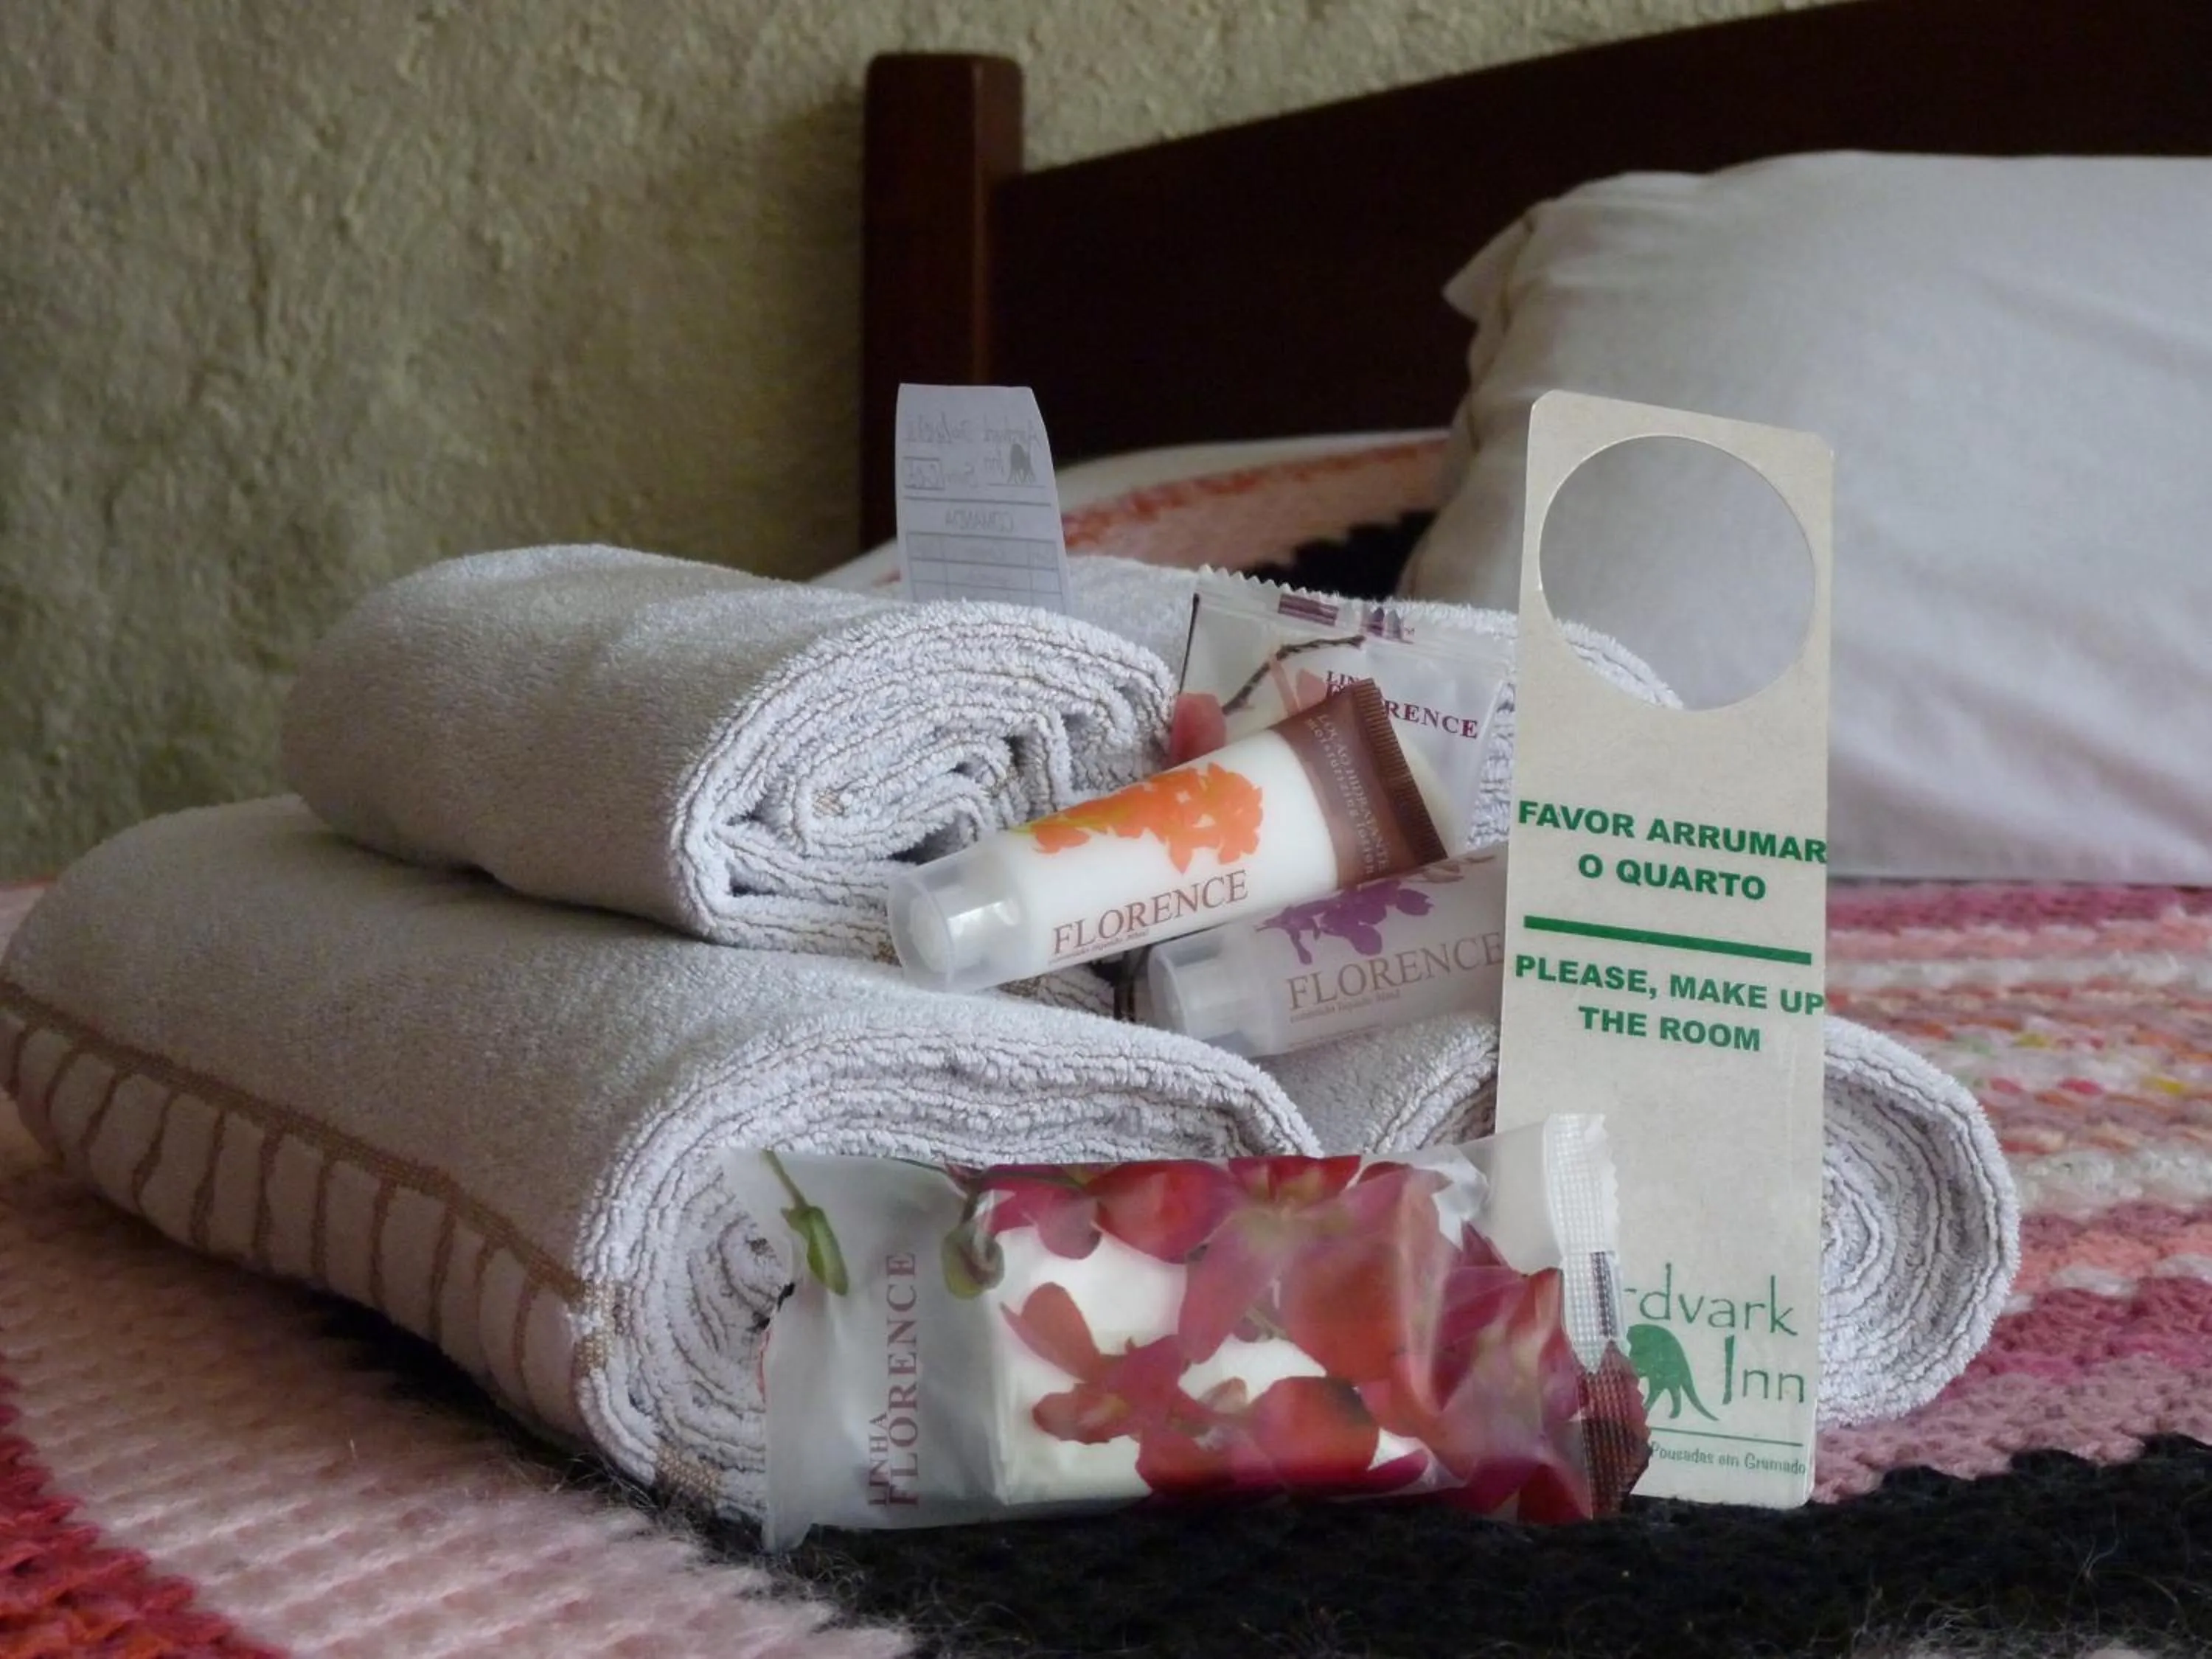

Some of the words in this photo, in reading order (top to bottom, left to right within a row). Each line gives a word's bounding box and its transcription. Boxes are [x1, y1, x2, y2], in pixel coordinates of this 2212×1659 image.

[1518, 800, 1635, 838] FAVOR
[1646, 818, 1826, 864] ARRUMAR
[1052, 869, 1249, 955] FLORENCE
[1578, 854, 1603, 878] O
[1615, 859, 1767, 900] QUARTO
[1286, 931, 1504, 1010] FLORENCE
[1515, 955, 1658, 1000] PLEASE,
[1669, 975, 1767, 1009] MAKE
[1780, 989, 1824, 1015] UP
[1578, 1006, 1646, 1037] THE
[1660, 1016, 1761, 1051] ROOM
[1624, 1262, 1798, 1337] dvark
[887, 1252, 919, 1509] FLORENCE
[1721, 1335, 1805, 1405] Inn
[868, 1411, 889, 1506] LINHA
[1745, 1453, 1806, 1475] Gramado
